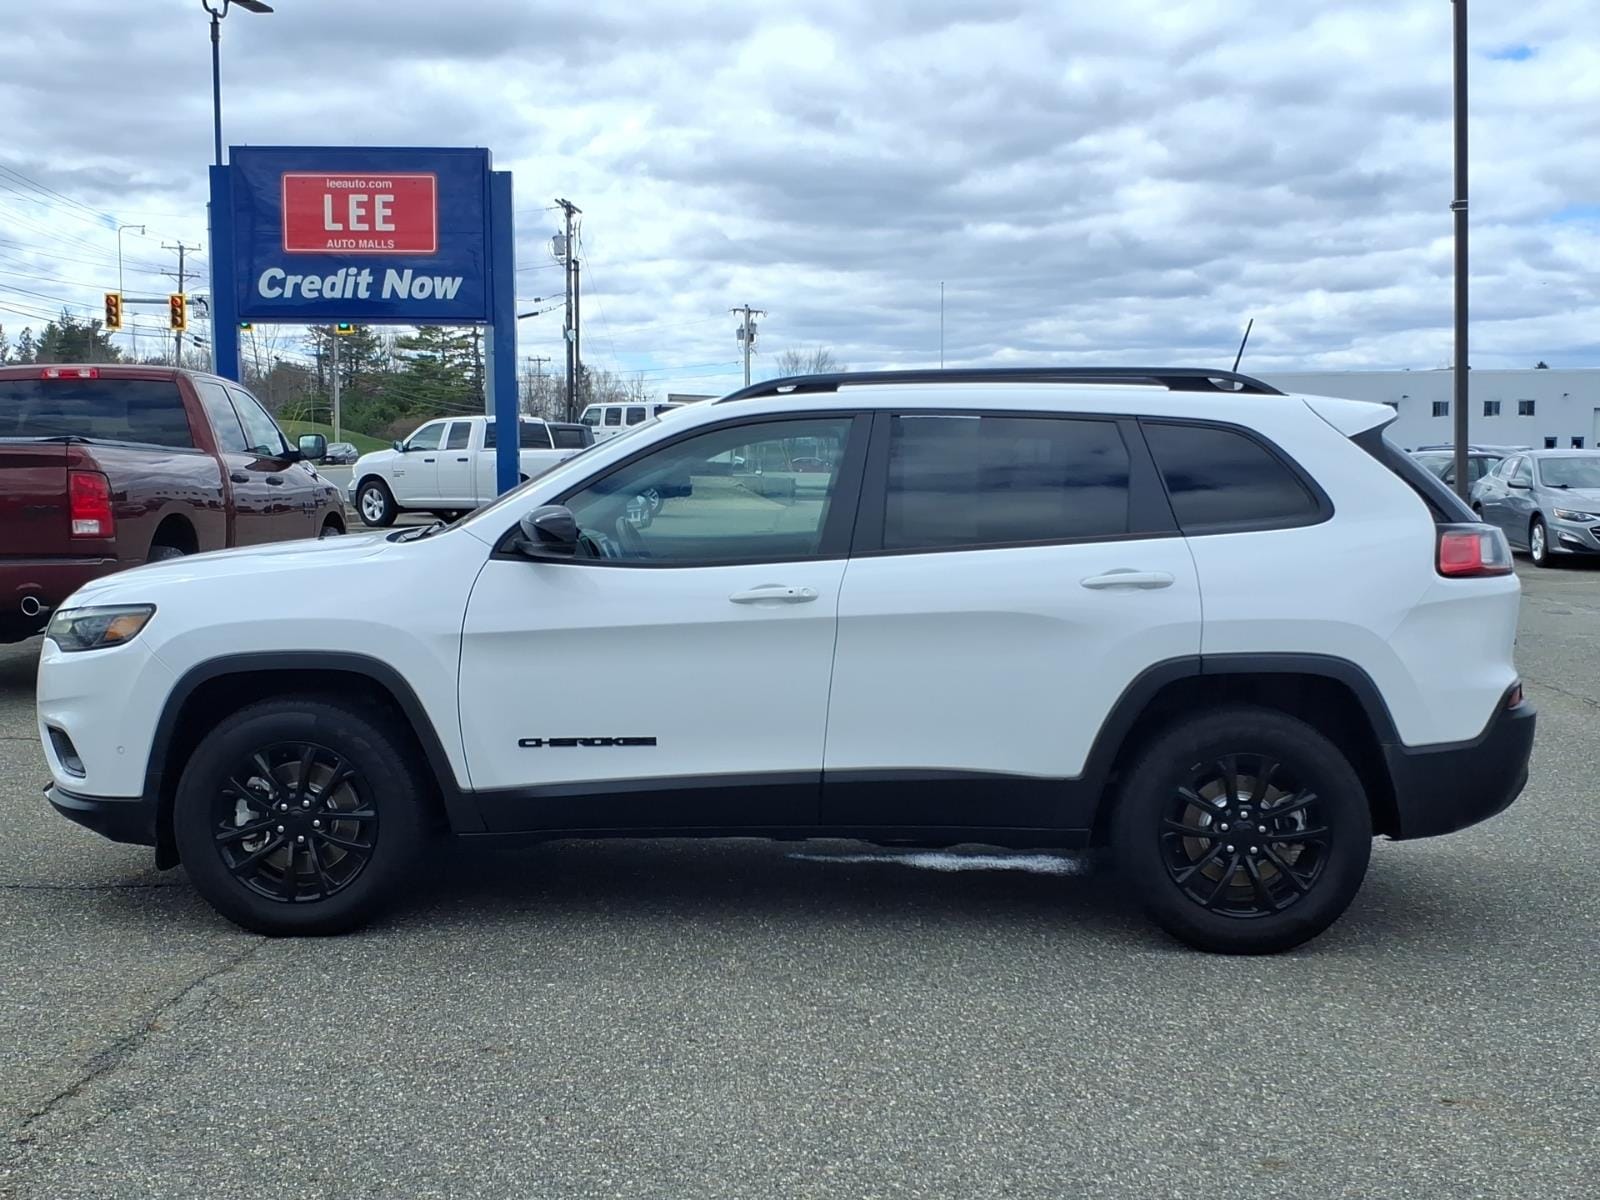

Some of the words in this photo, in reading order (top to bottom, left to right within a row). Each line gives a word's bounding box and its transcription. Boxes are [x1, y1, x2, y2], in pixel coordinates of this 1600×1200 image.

[326, 178, 392, 189] leeauto.com
[324, 194, 395, 231] LEE
[327, 239, 355, 249] AUTO
[359, 239, 395, 249] MALLS
[258, 267, 373, 299] Credit
[382, 269, 463, 299] Now
